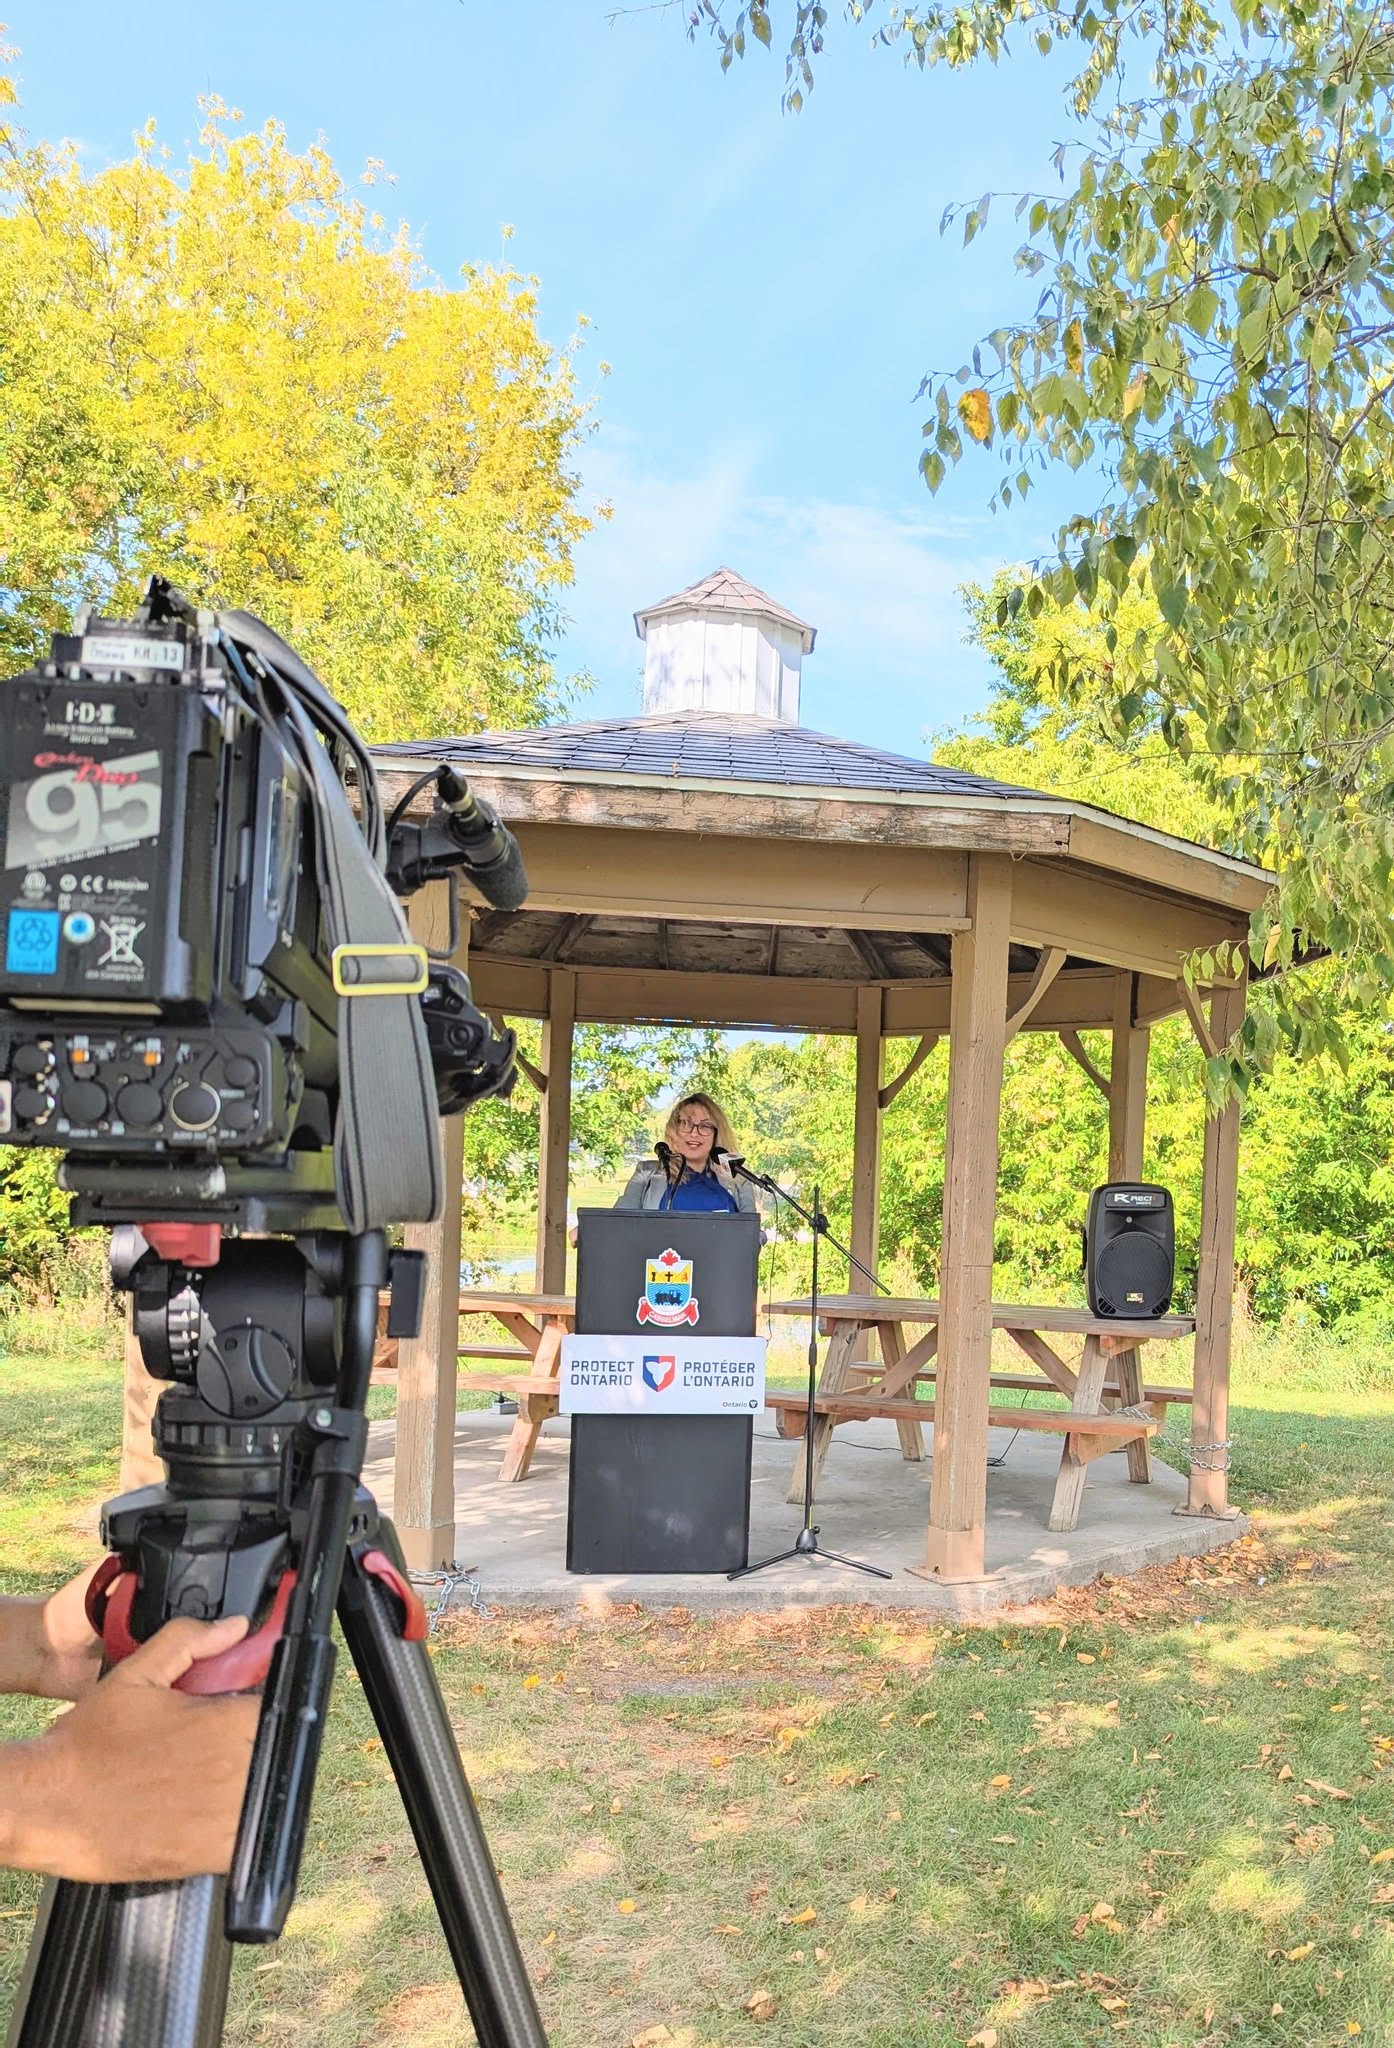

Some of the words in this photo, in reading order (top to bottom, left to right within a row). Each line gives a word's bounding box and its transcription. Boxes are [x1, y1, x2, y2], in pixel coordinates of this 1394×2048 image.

[162, 646, 178, 662] 13
[26, 749, 162, 856] 95
[571, 1360, 635, 1373] PROTECT
[683, 1359, 756, 1374] PROTÉGER
[570, 1374, 633, 1386] ONTARIO
[683, 1375, 755, 1387] L'ONTARIO
[722, 1400, 748, 1408] Ontario
